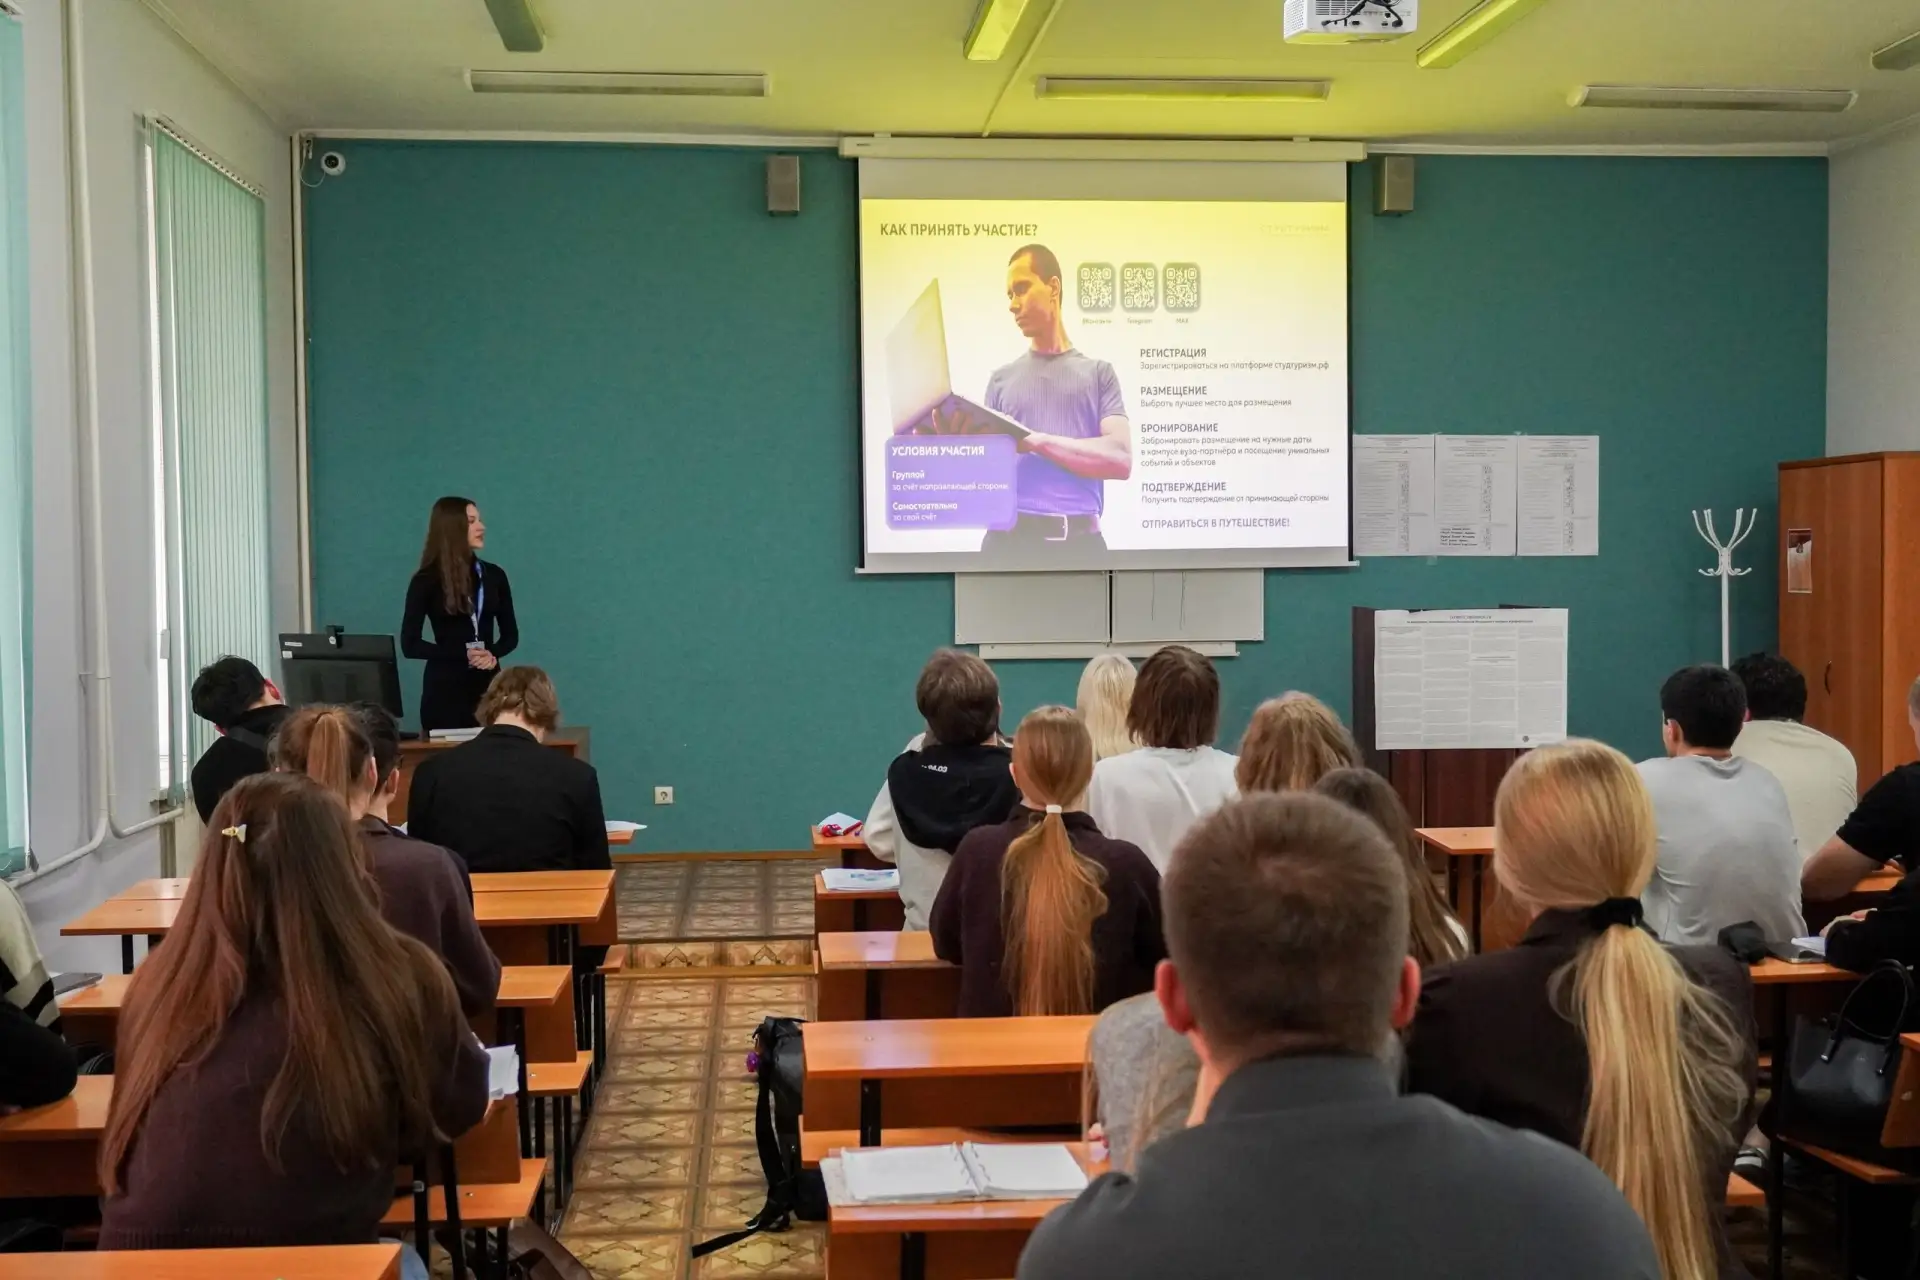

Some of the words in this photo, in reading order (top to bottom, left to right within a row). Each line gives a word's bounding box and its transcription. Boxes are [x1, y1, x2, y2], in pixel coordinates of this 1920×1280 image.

[880, 223, 907, 236] КАК
[910, 223, 970, 236] ПРИНЯТЬ
[973, 223, 1038, 236] УЧАСТИЕ?
[1140, 348, 1207, 359] РЕГИСТРАЦИЯ
[1140, 362, 1217, 370] Зарегистрироваться
[1231, 362, 1273, 370] платформе
[1141, 386, 1207, 396] РАЗМЕЩЕНИЕ
[1140, 400, 1172, 408] Выбрать
[1175, 400, 1203, 408] лучшее
[1244, 399, 1292, 408] размещения
[1141, 423, 1218, 433] БРОНИРОВАНИЕ
[892, 446, 938, 456] УСЛОВИЯ
[940, 446, 984, 456] УЧАСТИЯ
[1287, 447, 1330, 455] уникальных
[892, 470, 925, 480] Группой
[1141, 482, 1226, 493] ПОДТВЕРЖДЕНИЕ
[1141, 496, 1177, 504] Получить
[1179, 495, 1235, 504] подтверждение
[1246, 494, 1298, 503] принимающей
[1300, 495, 1329, 503] стороны
[1142, 519, 1209, 528] ОТПРАВИТЬСЯ
[1219, 518, 1290, 528] ПУТЕШЕСТВИЕ!
